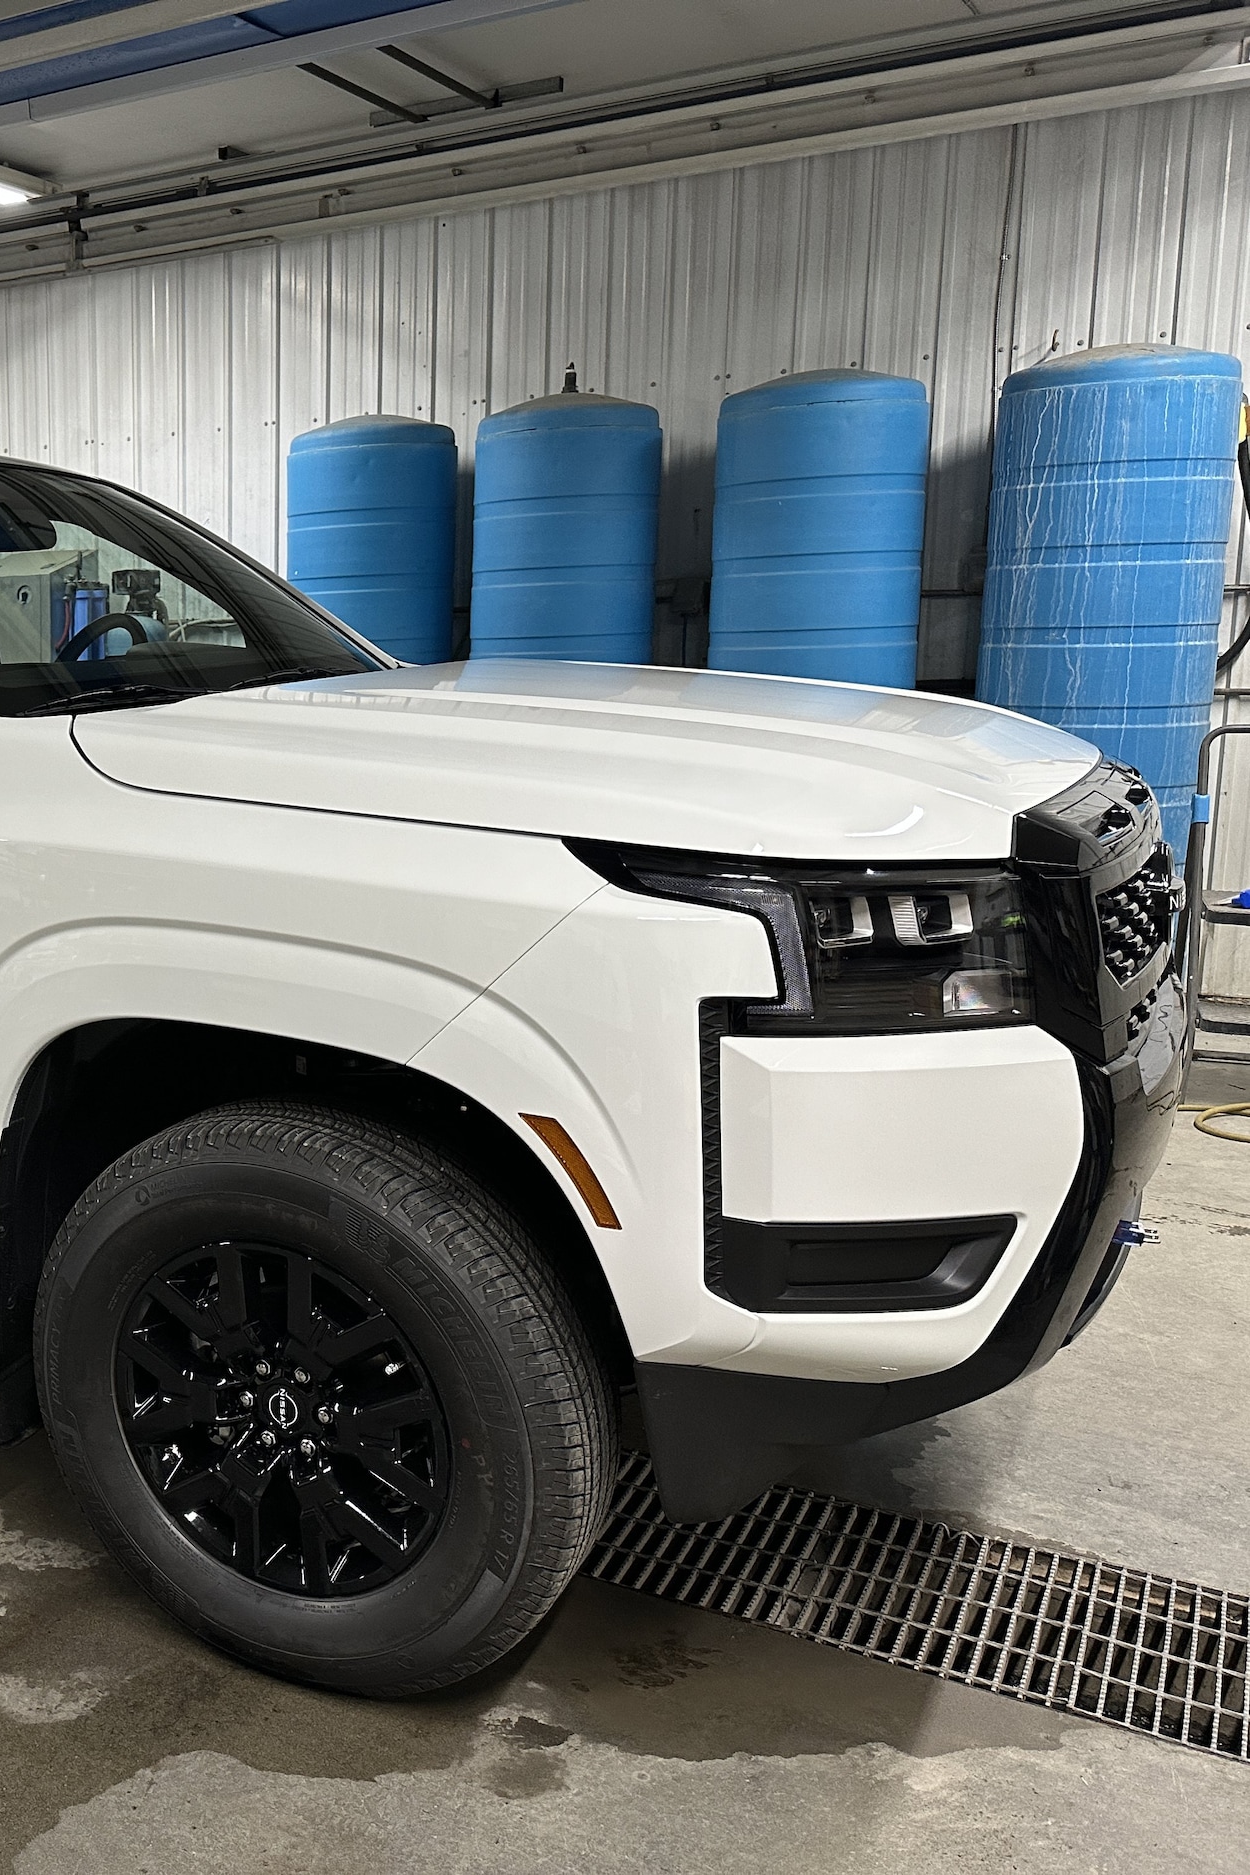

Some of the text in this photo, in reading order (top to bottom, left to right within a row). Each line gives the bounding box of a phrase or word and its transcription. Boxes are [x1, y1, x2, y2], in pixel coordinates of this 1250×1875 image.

[49, 1323, 62, 1405] PRIMACY
[393, 1256, 508, 1421] MICHELIN
[277, 1388, 289, 1430] NISSAN
